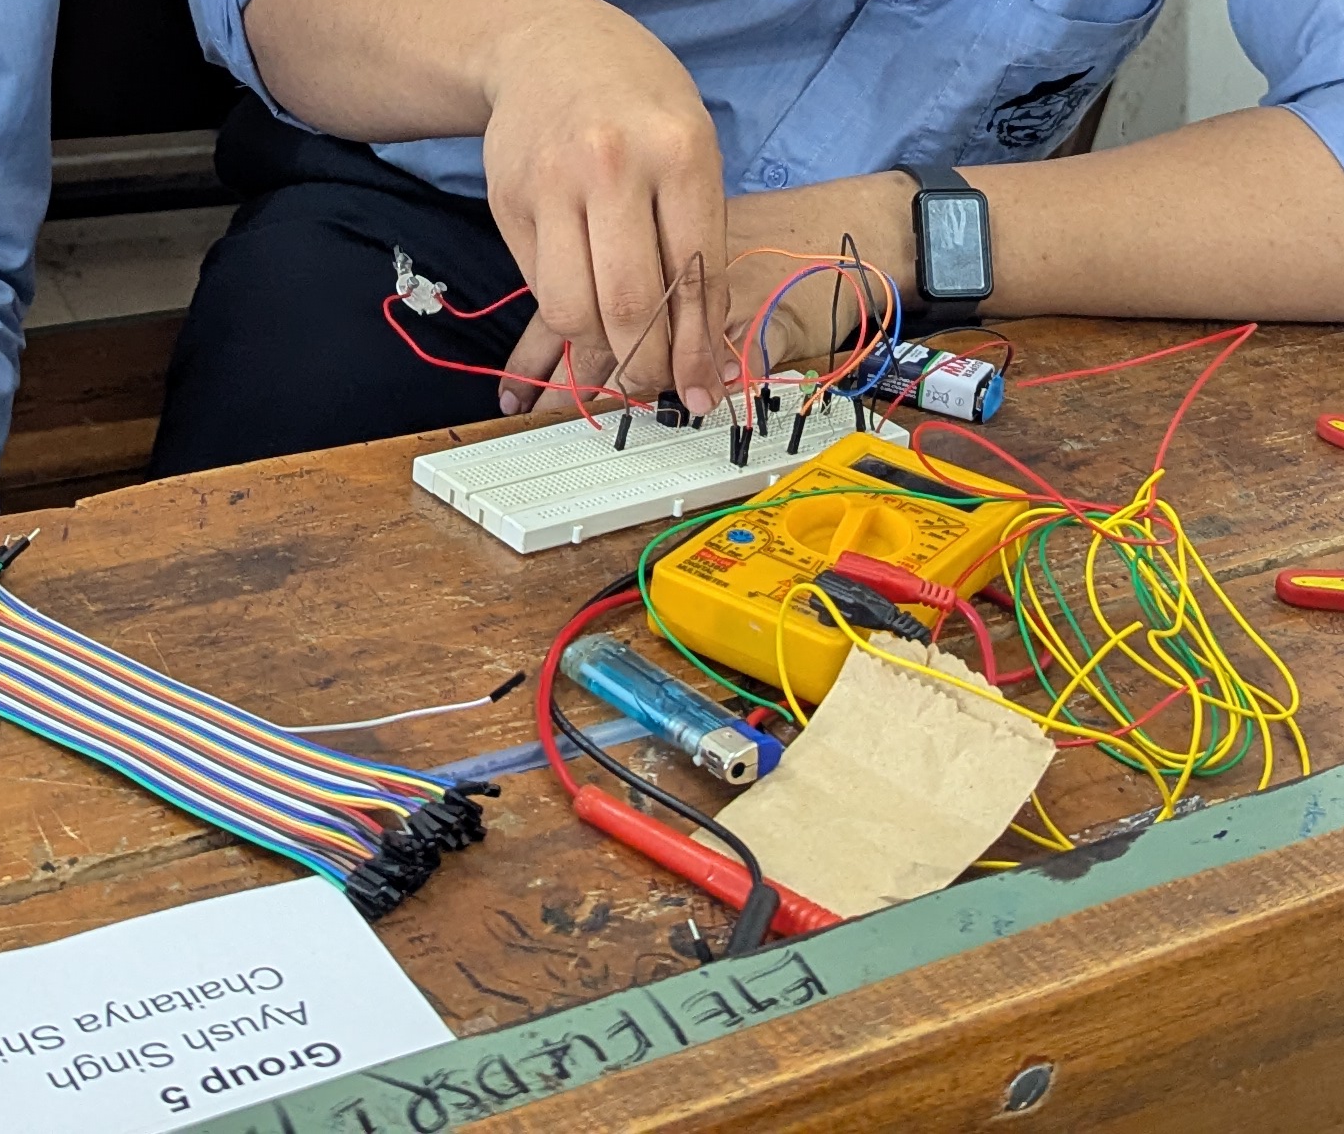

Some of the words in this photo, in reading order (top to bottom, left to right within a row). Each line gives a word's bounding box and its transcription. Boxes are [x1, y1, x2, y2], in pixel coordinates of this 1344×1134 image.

[73, 965, 284, 1034] Chaitanya
[181, 1000, 309, 1053] Ayush
[46, 1041, 175, 1092] Singh
[200, 1041, 342, 1094] Group
[159, 1085, 192, 1114] 5
